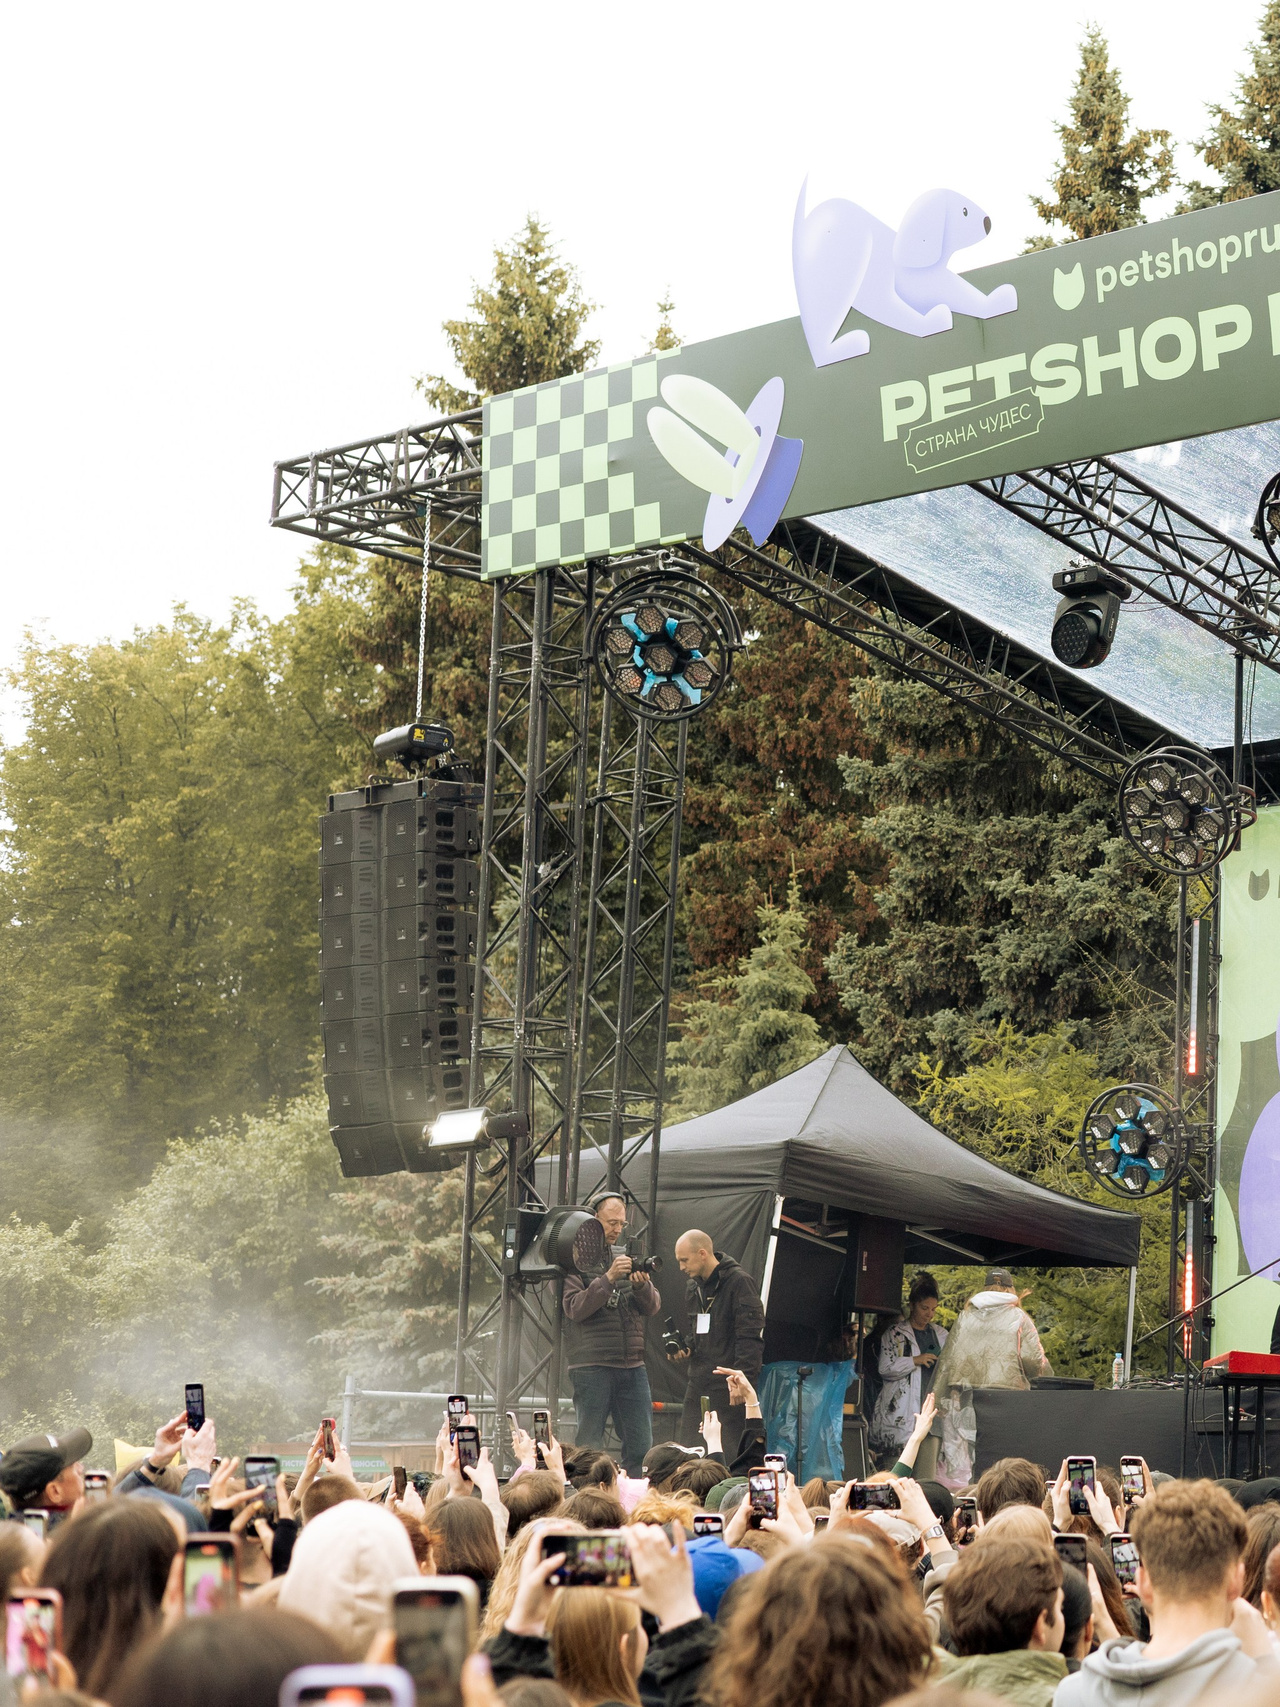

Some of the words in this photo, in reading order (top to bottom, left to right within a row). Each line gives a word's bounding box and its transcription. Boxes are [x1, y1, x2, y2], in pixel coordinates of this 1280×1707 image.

[880, 303, 1253, 442] PETSHOP
[915, 423, 978, 457] СТРАНА
[979, 403, 1032, 433] ЧУДЕС
